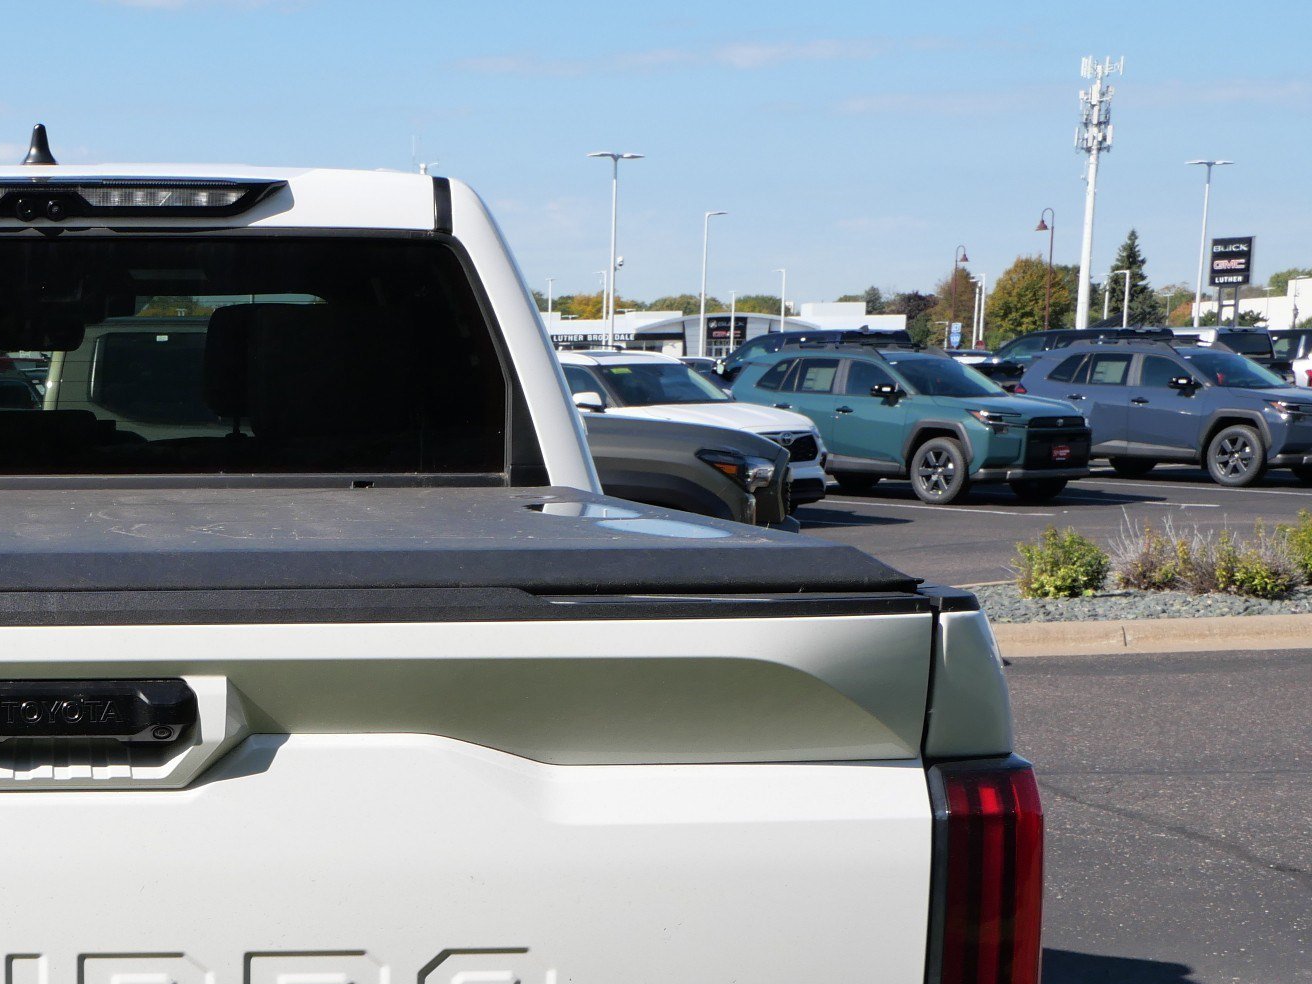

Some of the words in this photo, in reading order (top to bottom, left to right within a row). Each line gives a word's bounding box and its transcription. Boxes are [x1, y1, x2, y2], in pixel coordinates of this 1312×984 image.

[1213, 244, 1249, 252] BUICK
[1213, 259, 1246, 270] GMC
[587, 333, 635, 341] BROODALE
[0, 700, 123, 724] TOYOTA
